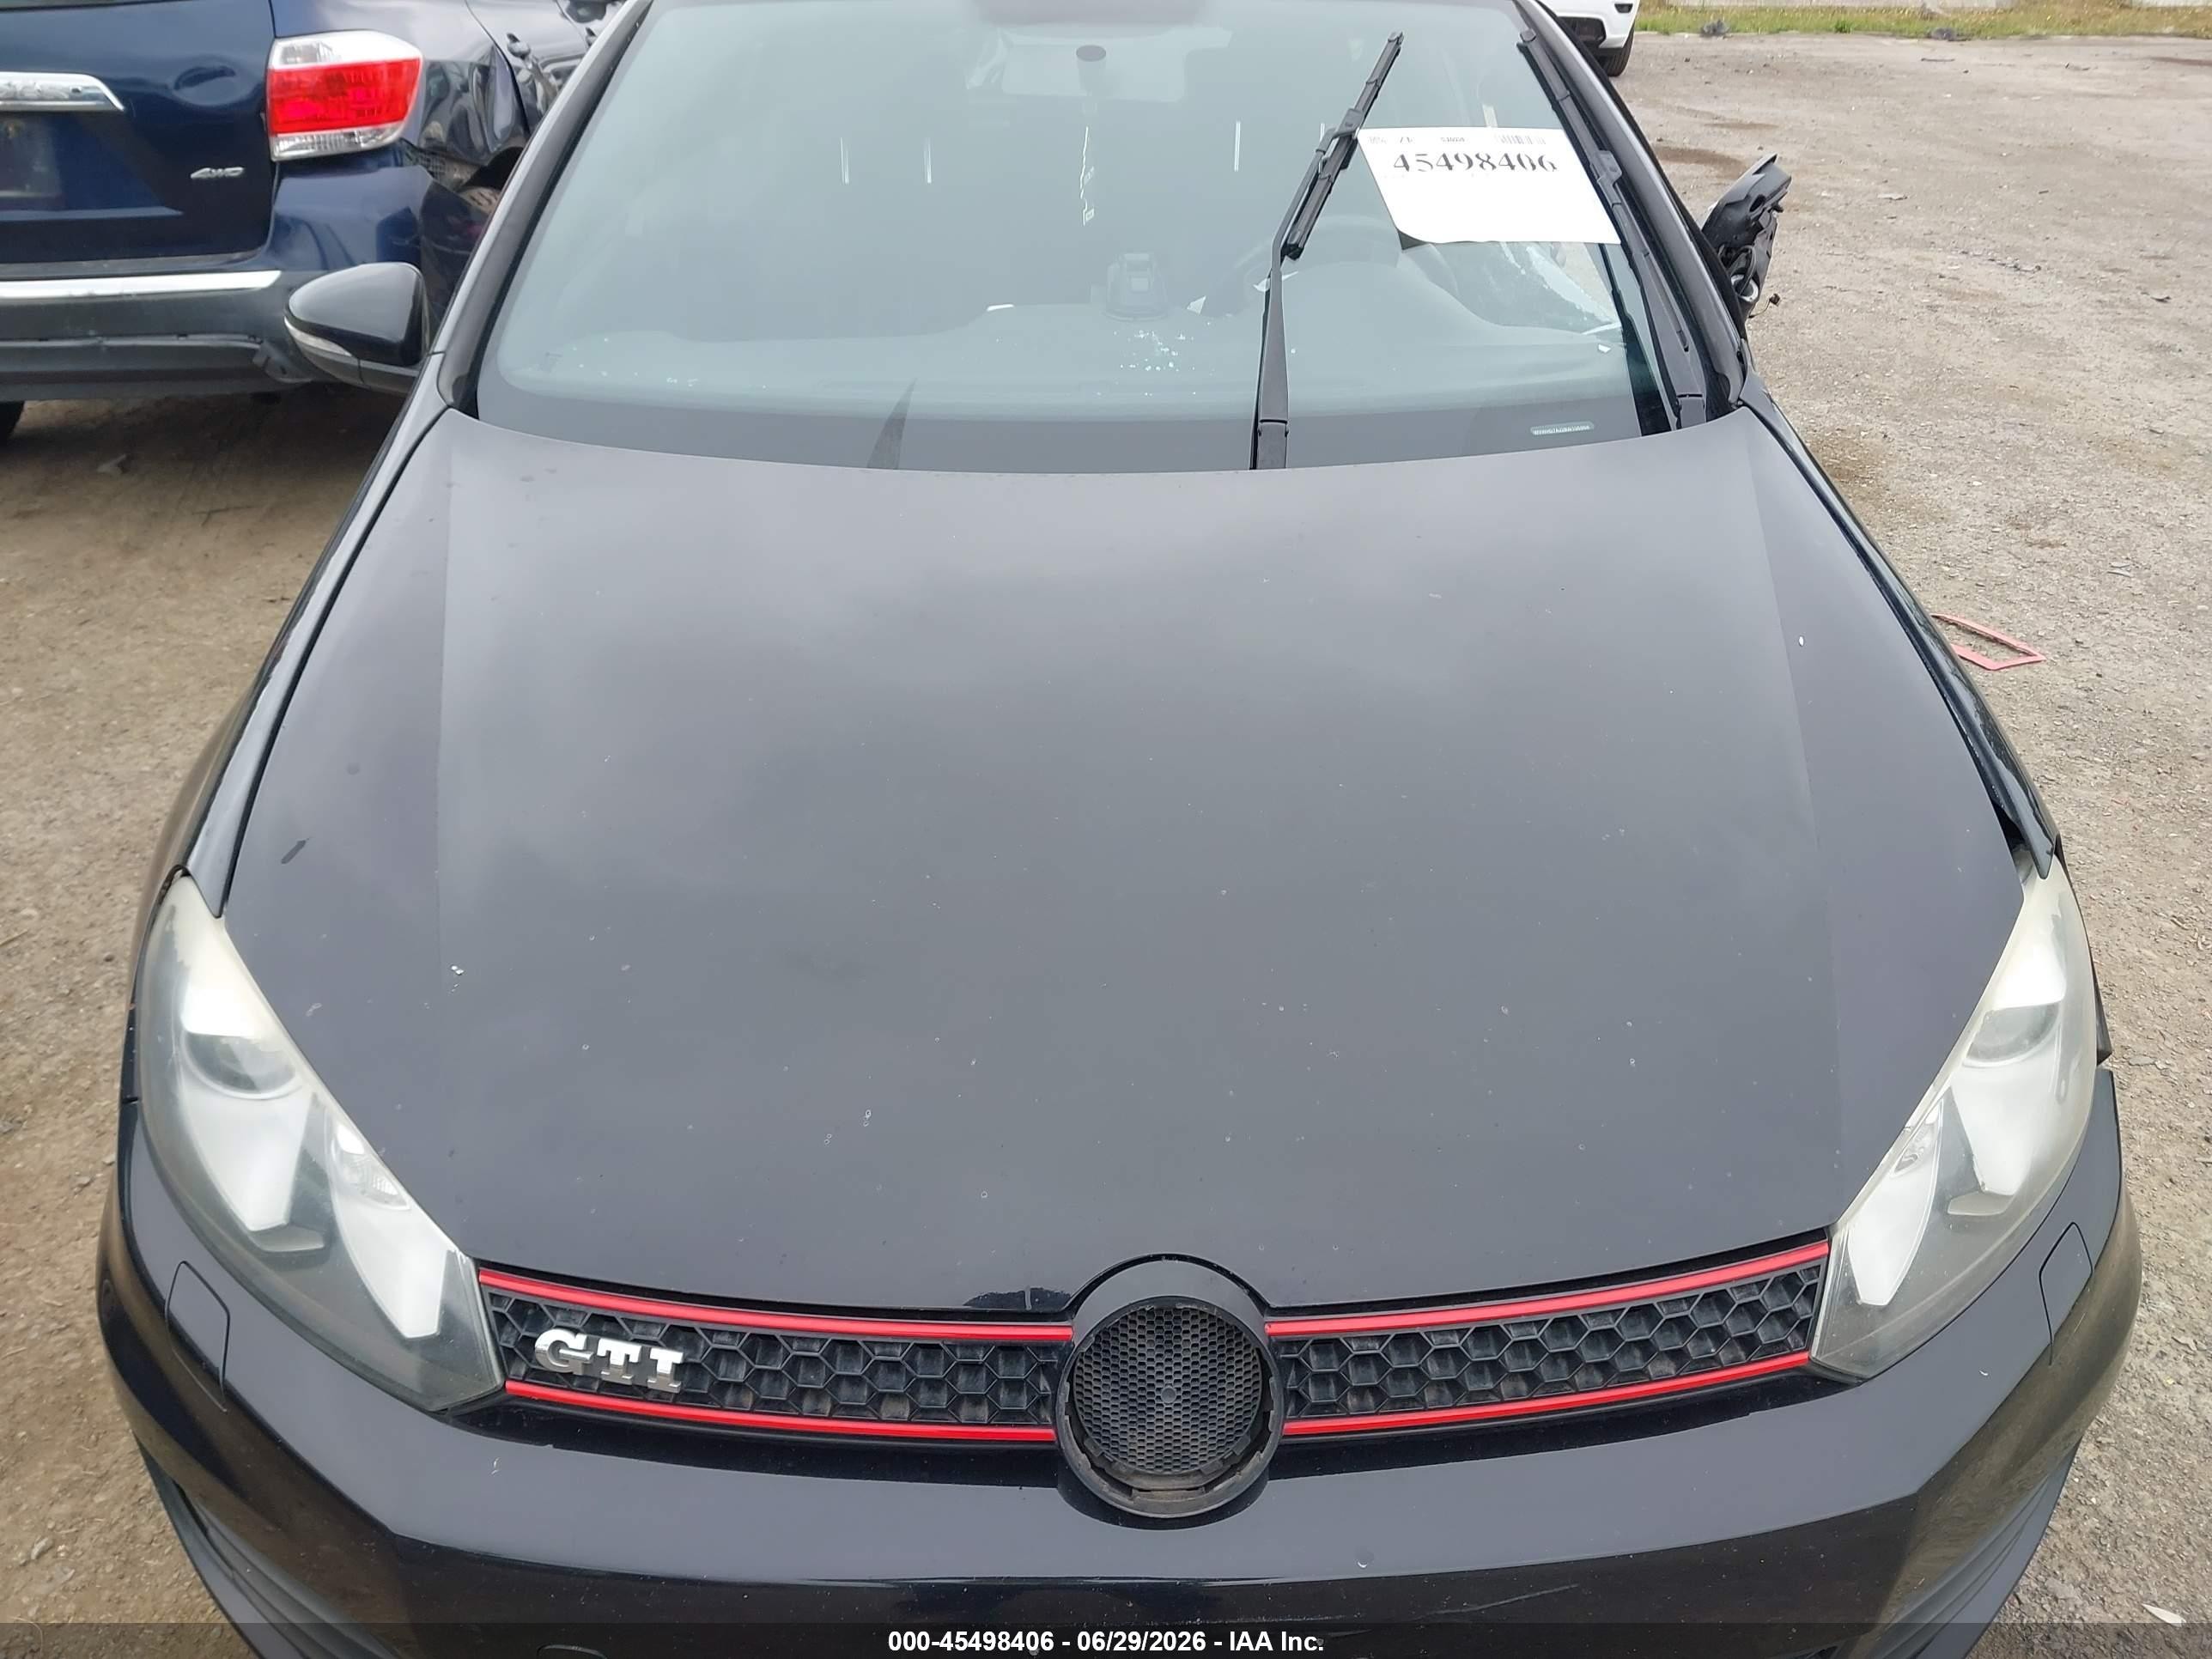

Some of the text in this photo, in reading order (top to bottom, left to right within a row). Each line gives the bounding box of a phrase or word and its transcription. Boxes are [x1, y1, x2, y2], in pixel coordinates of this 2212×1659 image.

[190, 167, 245, 179] 4WD
[1393, 152, 1558, 173] 45498406
[534, 1328, 684, 1394] GTI
